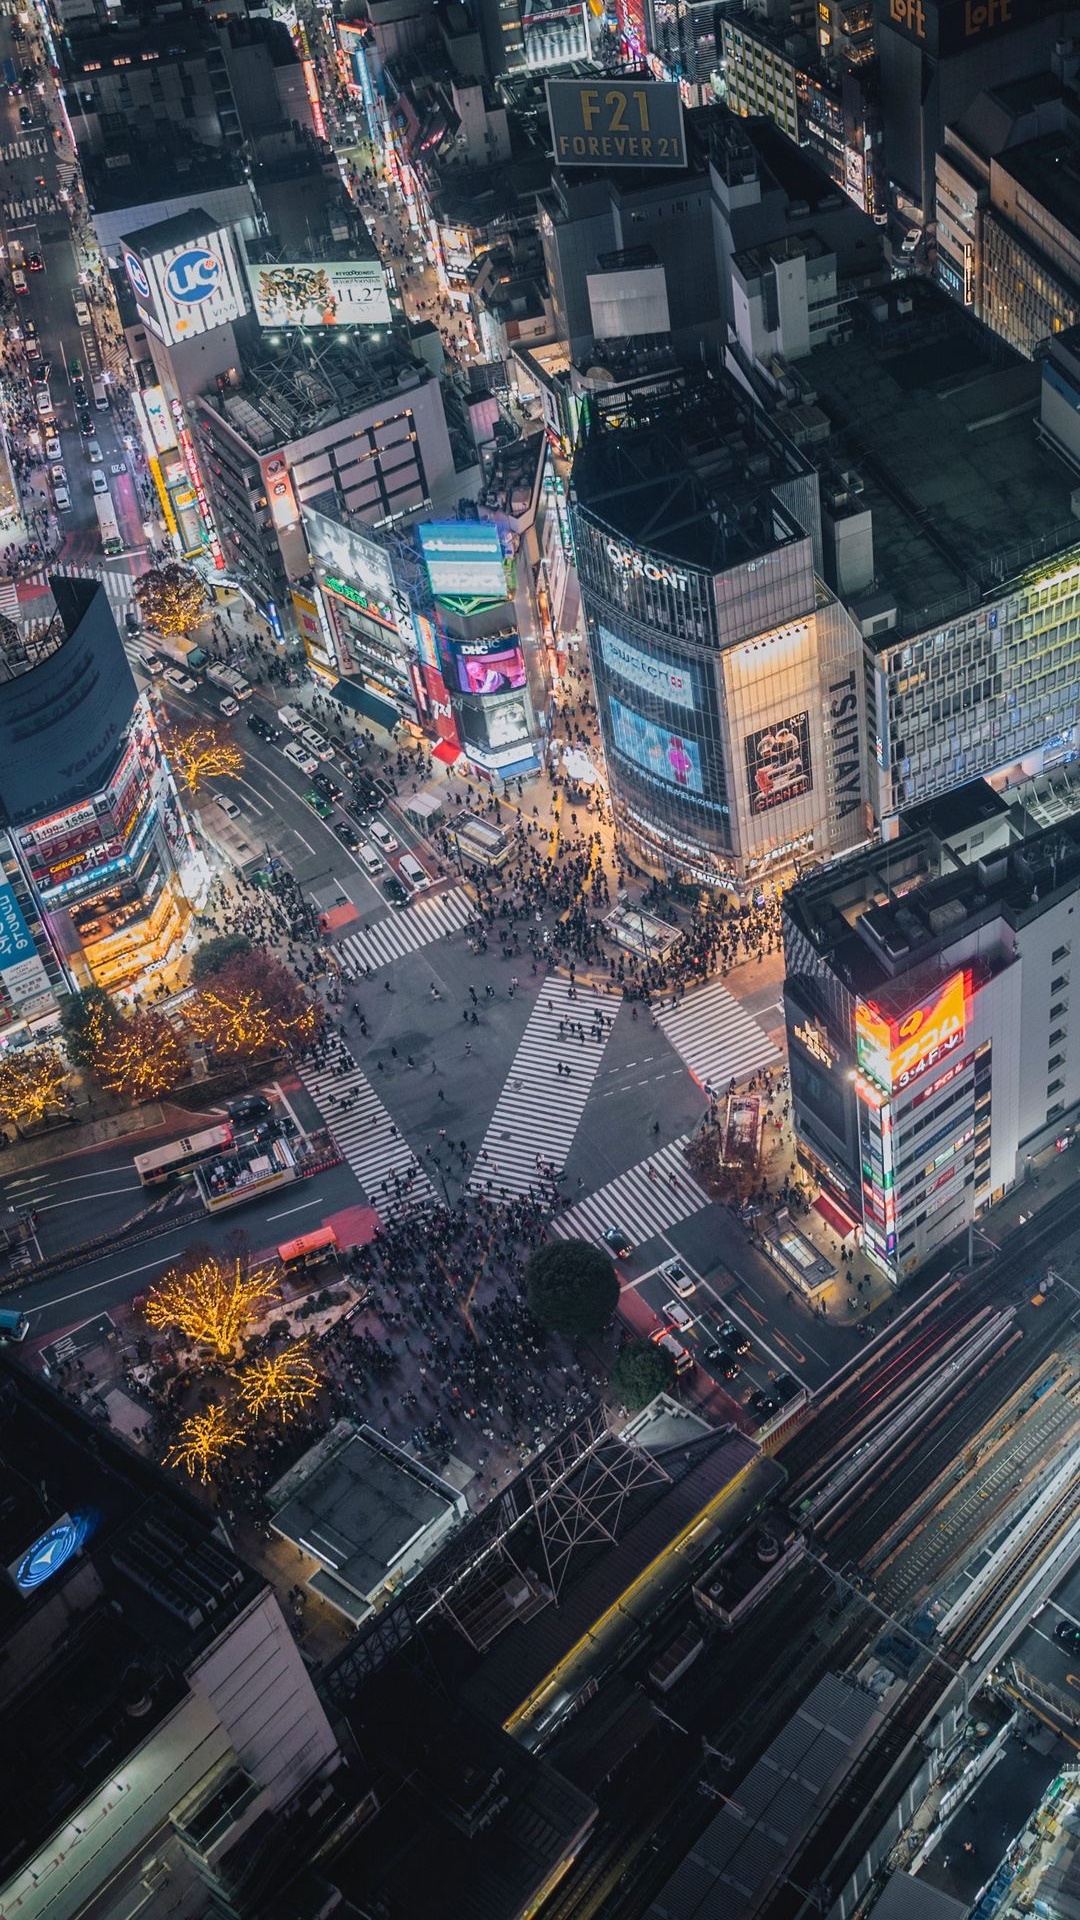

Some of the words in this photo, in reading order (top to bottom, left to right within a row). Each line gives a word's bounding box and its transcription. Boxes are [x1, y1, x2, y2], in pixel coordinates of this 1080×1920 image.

[580, 90, 650, 131] F21
[559, 136, 653, 157] FOREVER
[657, 138, 680, 157] 21
[337, 287, 383, 302] 11.27
[460, 645, 489, 655] DHC
[57, 722, 118, 779] Yakult
[829, 670, 863, 820] TSUTAYA
[755, 785, 808, 811] CHANEL
[764, 835, 815, 864] TSUTAYA
[689, 868, 736, 891] TSUTAYA
[891, 1015, 960, 1076] アコム
